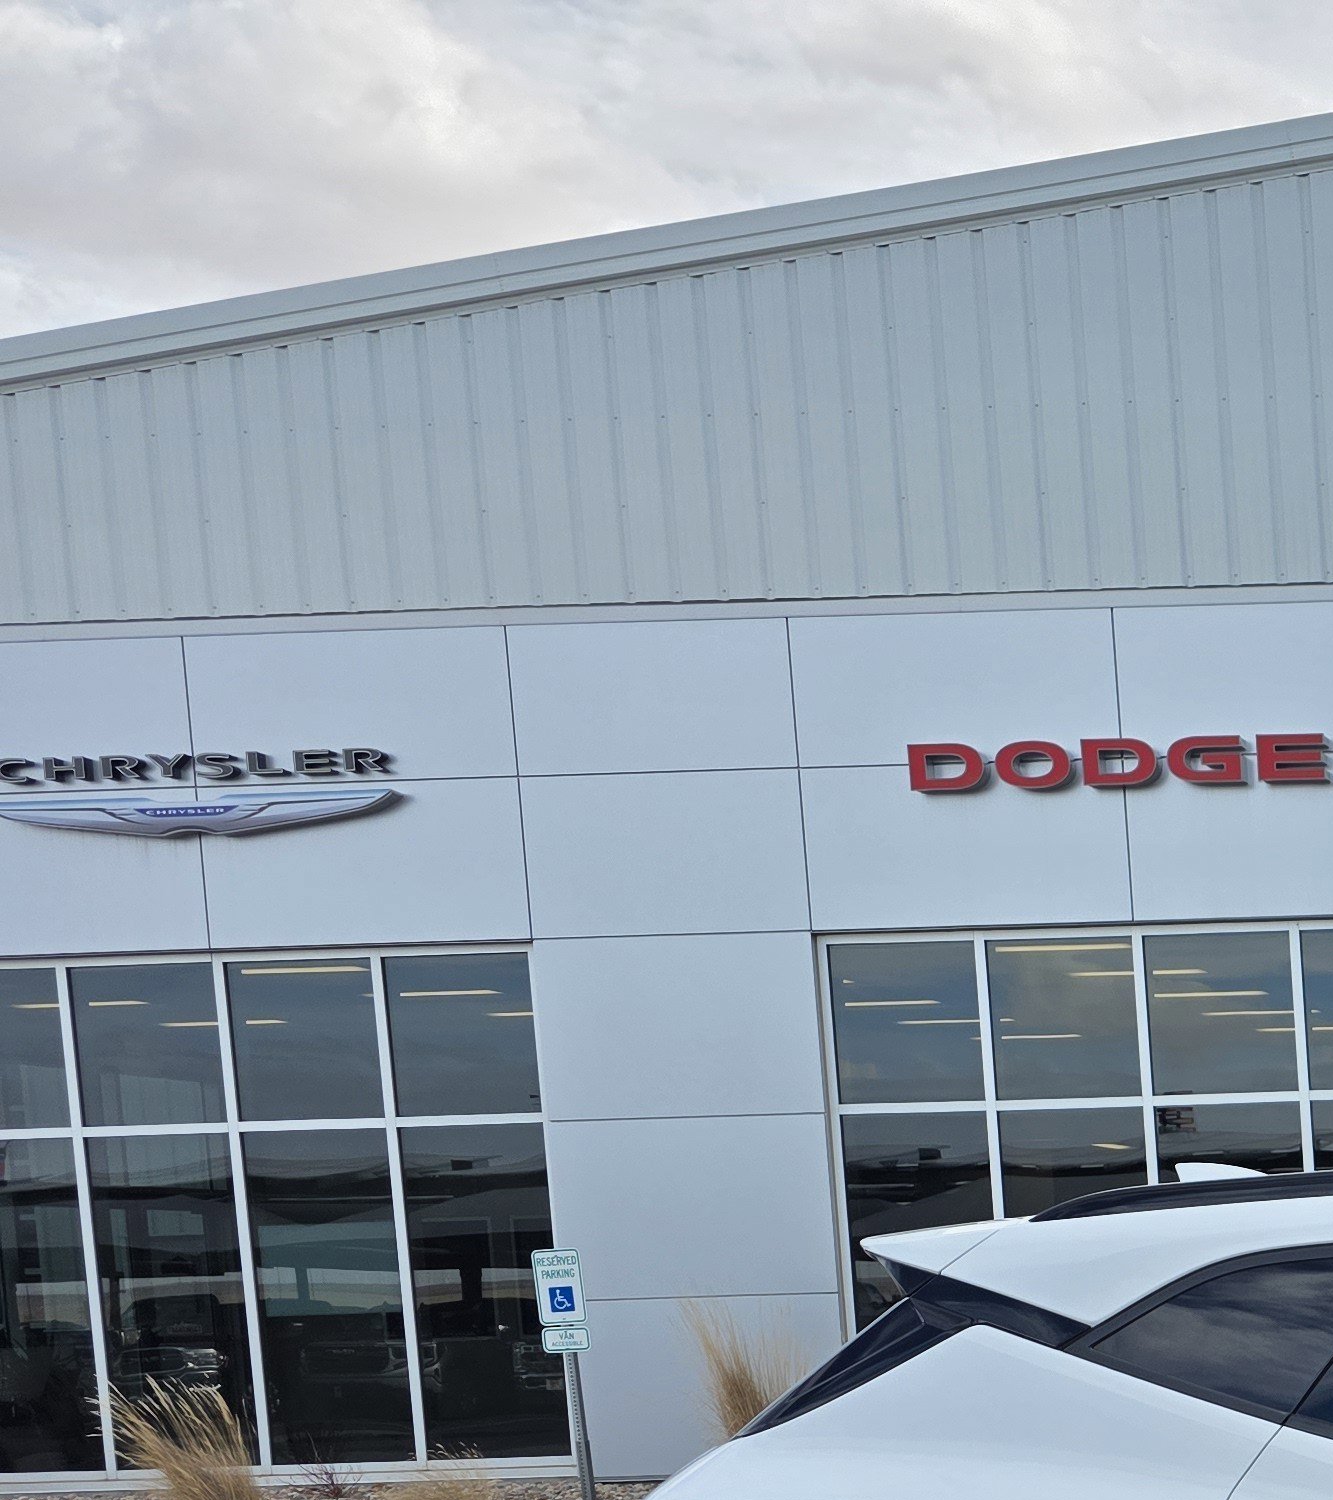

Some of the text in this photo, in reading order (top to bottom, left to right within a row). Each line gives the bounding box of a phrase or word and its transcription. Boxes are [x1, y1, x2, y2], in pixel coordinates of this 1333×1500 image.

[0, 747, 386, 784] CHRYSLER
[907, 732, 1332, 791] DODGE
[145, 808, 225, 816] CHRYSLER
[536, 1255, 577, 1267] RESERVED
[541, 1268, 575, 1279] PARKING
[559, 1332, 575, 1341] VAN
